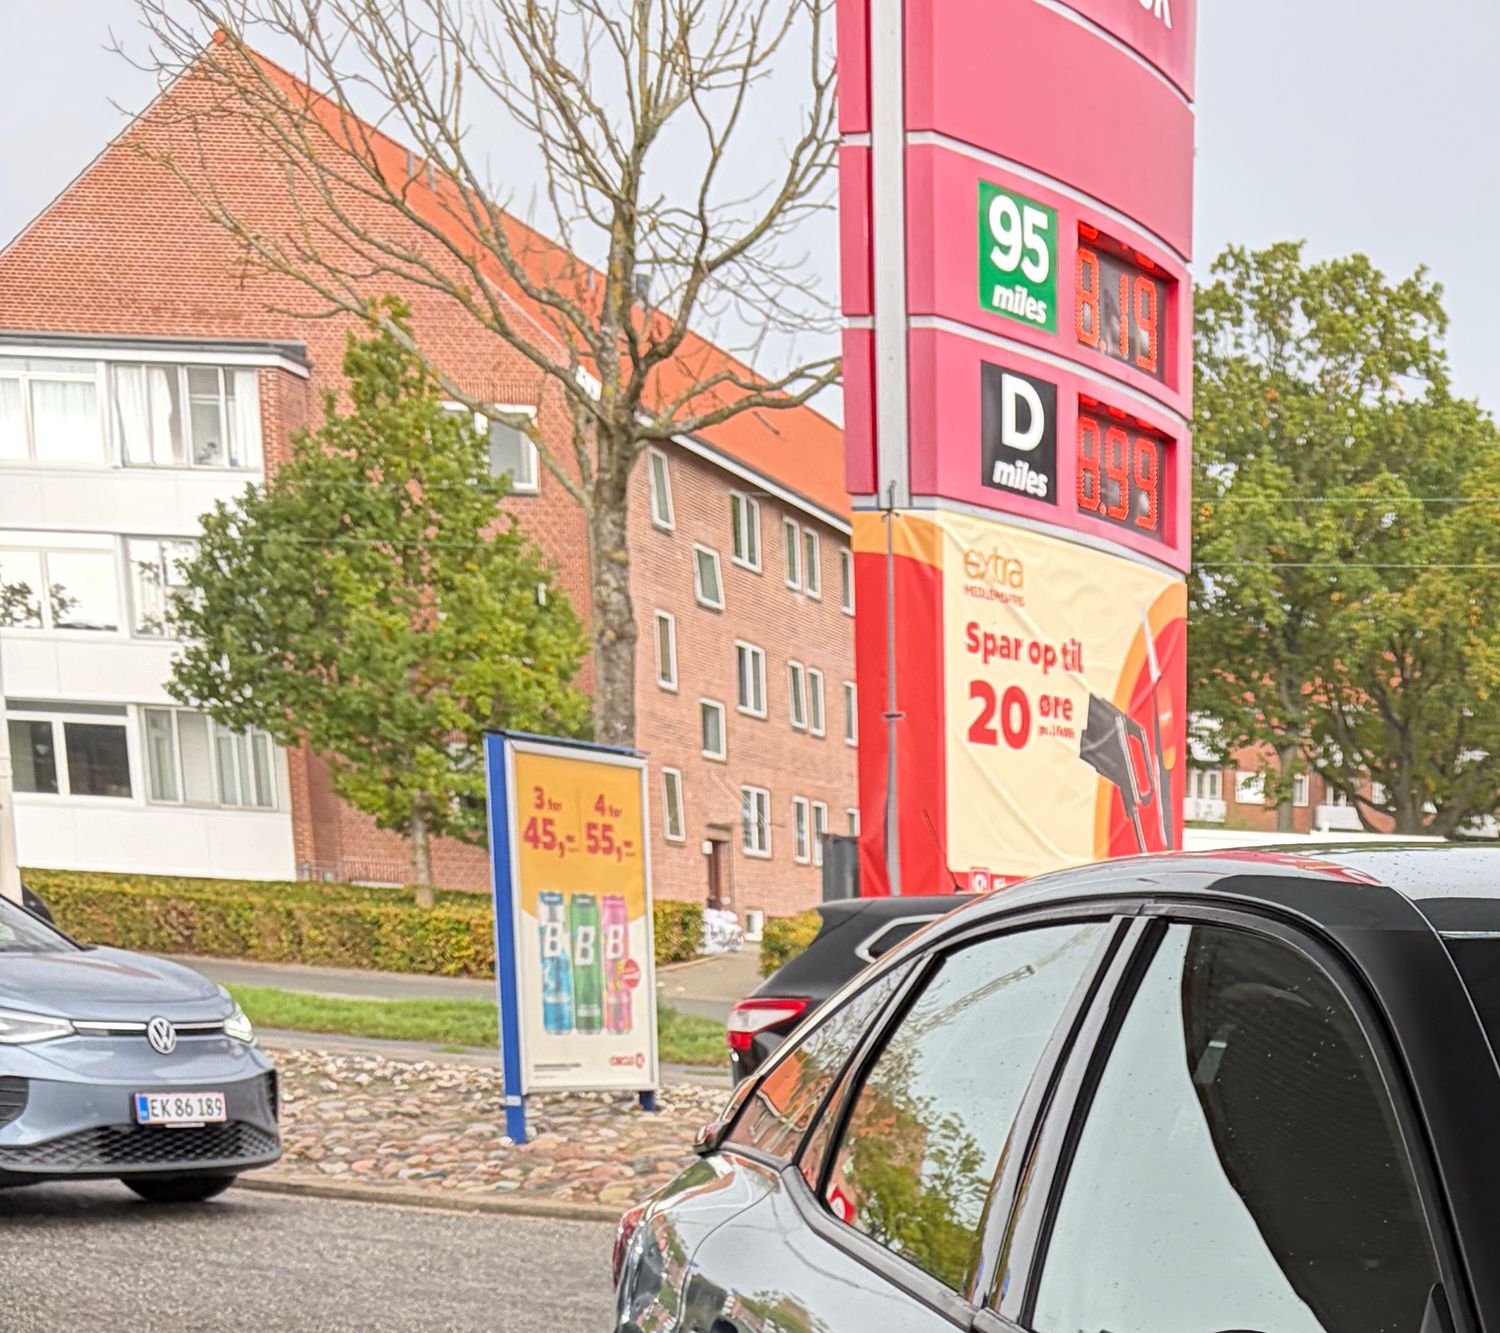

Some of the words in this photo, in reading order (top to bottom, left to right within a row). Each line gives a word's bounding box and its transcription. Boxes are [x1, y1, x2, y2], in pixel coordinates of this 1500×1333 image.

[989, 195, 1049, 284] 95
[992, 284, 1047, 324] miles
[1075, 247, 1158, 373] 8.19
[1001, 373, 1045, 451] D
[992, 460, 1048, 497] miles
[1077, 415, 1158, 530] 8.99
[963, 546, 1024, 589] extra
[966, 621, 1022, 664] Spar
[1029, 641, 1057, 675] op
[1061, 638, 1084, 673] til
[968, 680, 1031, 749] 20
[534, 786, 545, 810] 3
[595, 794, 605, 816] 4
[151, 1099, 172, 1117] EK
[174, 1098, 194, 1117] 86
[198, 1097, 223, 1116] 189
